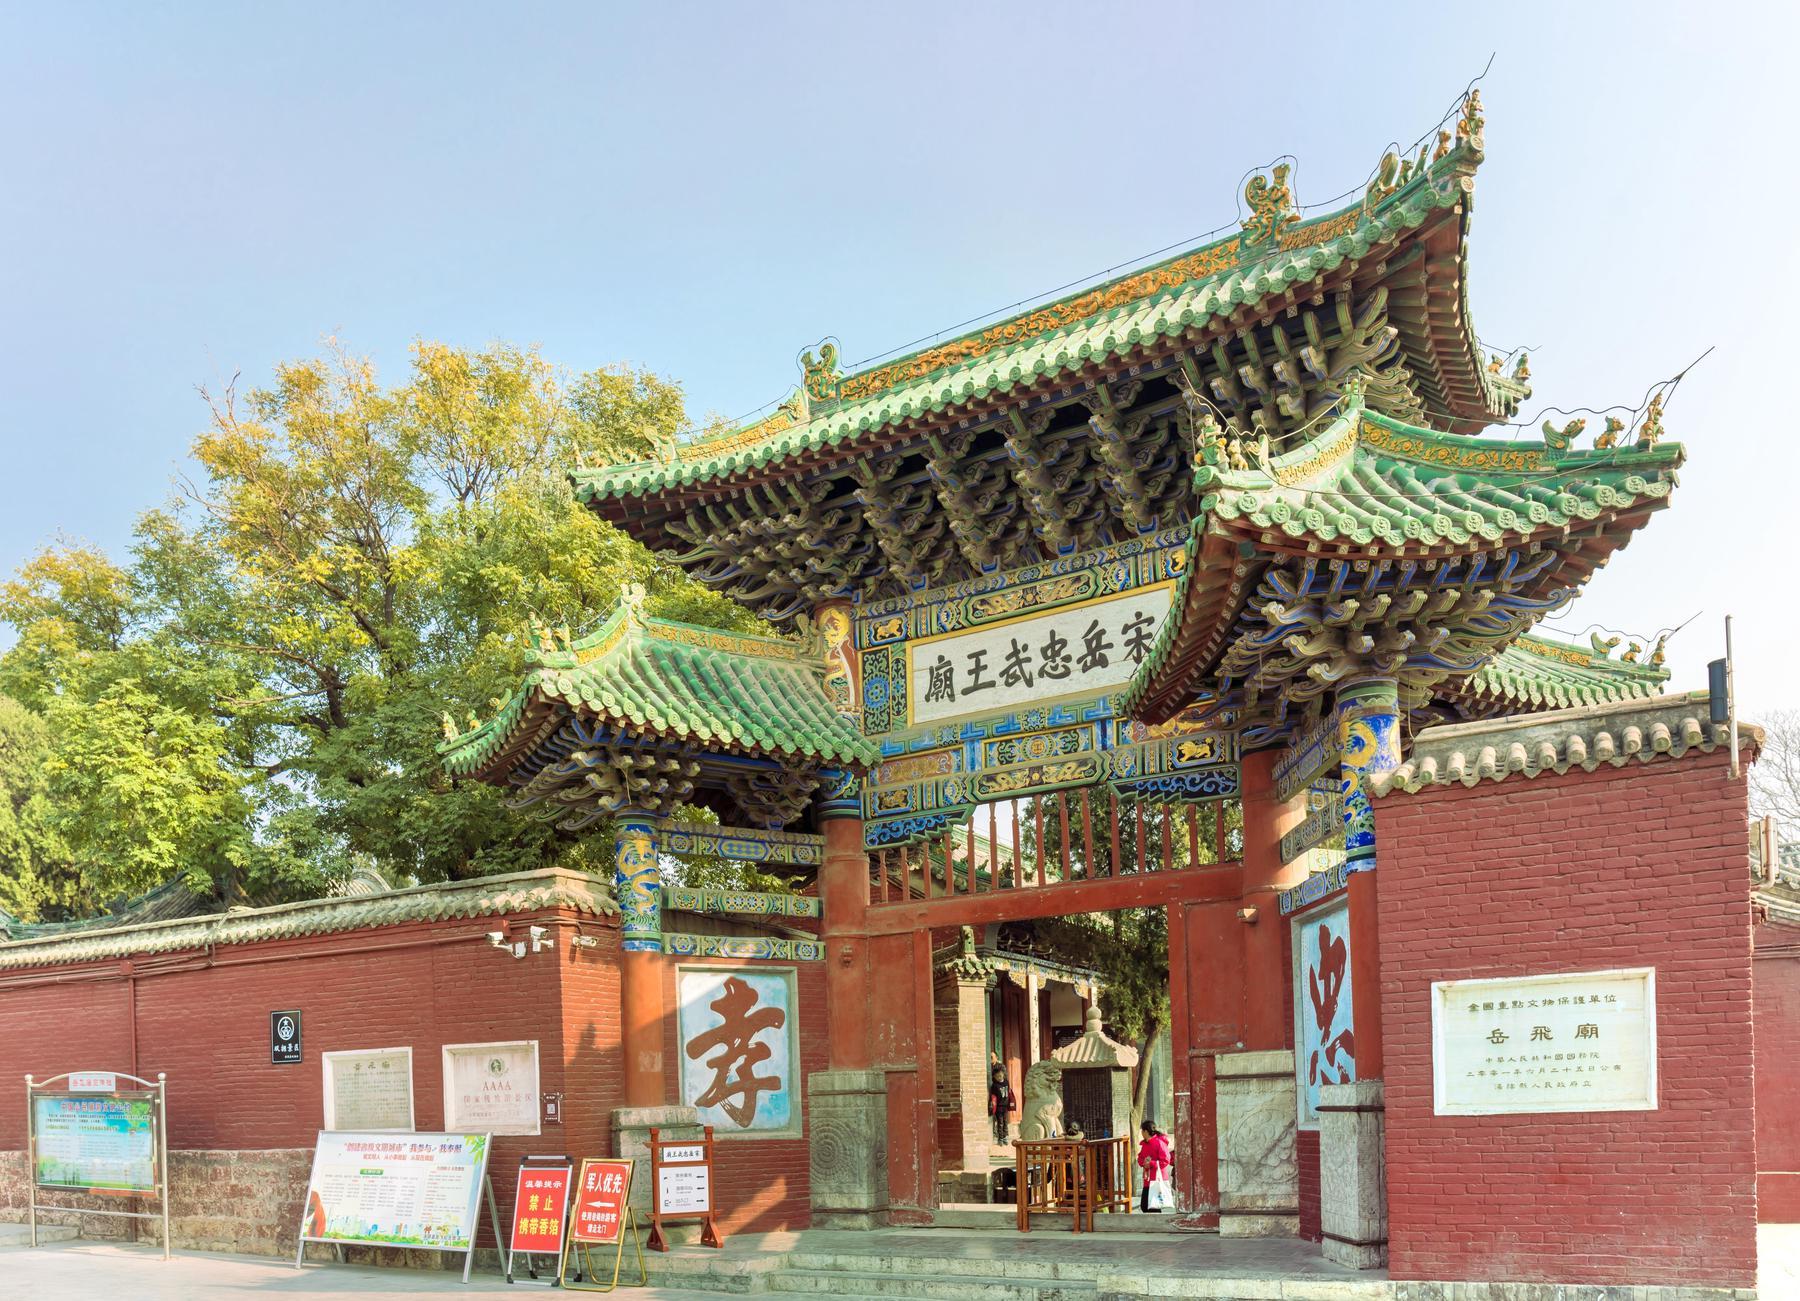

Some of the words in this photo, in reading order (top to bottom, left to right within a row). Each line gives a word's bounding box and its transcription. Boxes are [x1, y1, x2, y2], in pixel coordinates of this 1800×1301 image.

[1467, 994, 1617, 1012] 全國重點文物保護單位
[1486, 1023, 1600, 1045] 岳飛廟
[686, 976, 786, 1129] 孝
[482, 1081, 512, 1092] AAAA
[525, 1180, 563, 1189] 温馨提示
[585, 1172, 623, 1194] 军人优先
[528, 1194, 553, 1212] 禁止
